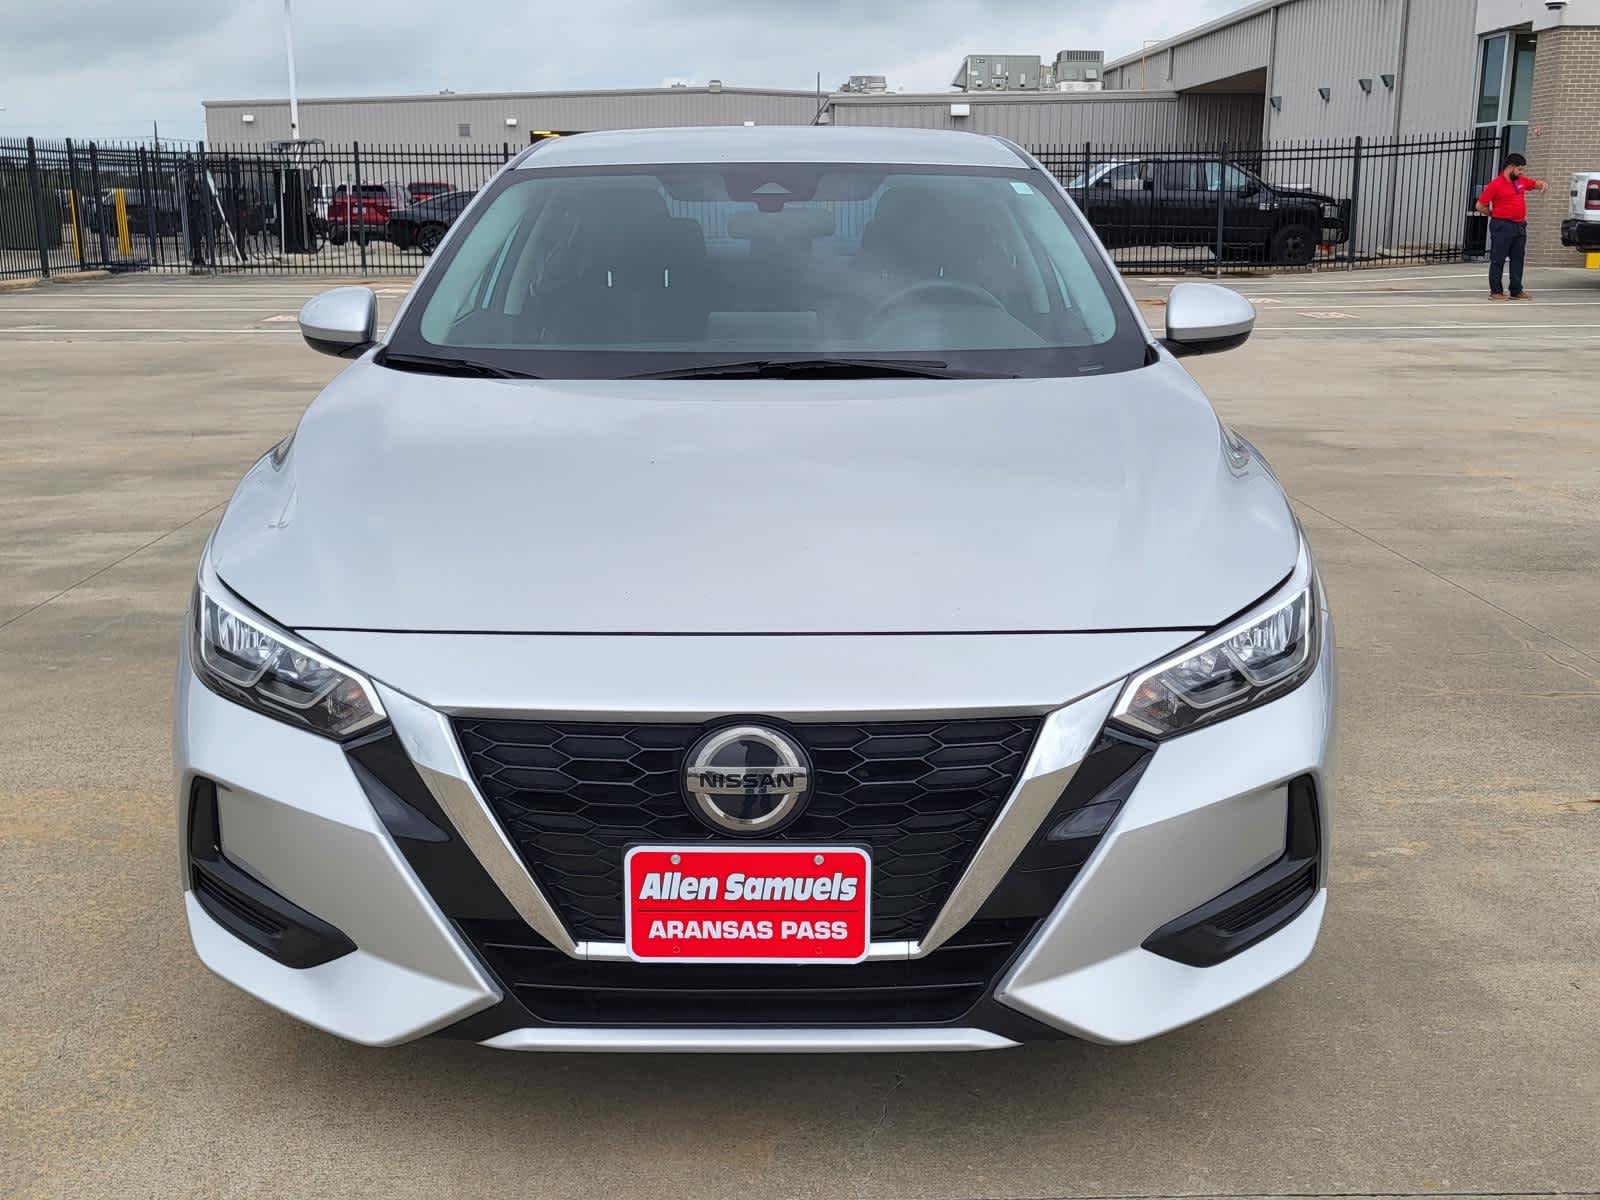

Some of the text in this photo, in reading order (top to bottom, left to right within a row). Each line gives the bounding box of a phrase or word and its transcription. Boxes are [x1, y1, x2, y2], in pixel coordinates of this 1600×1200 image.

[700, 773, 795, 788] NISSAN
[639, 872, 858, 901] Allen Samuels
[648, 920, 848, 939] ARANSAS PASS
